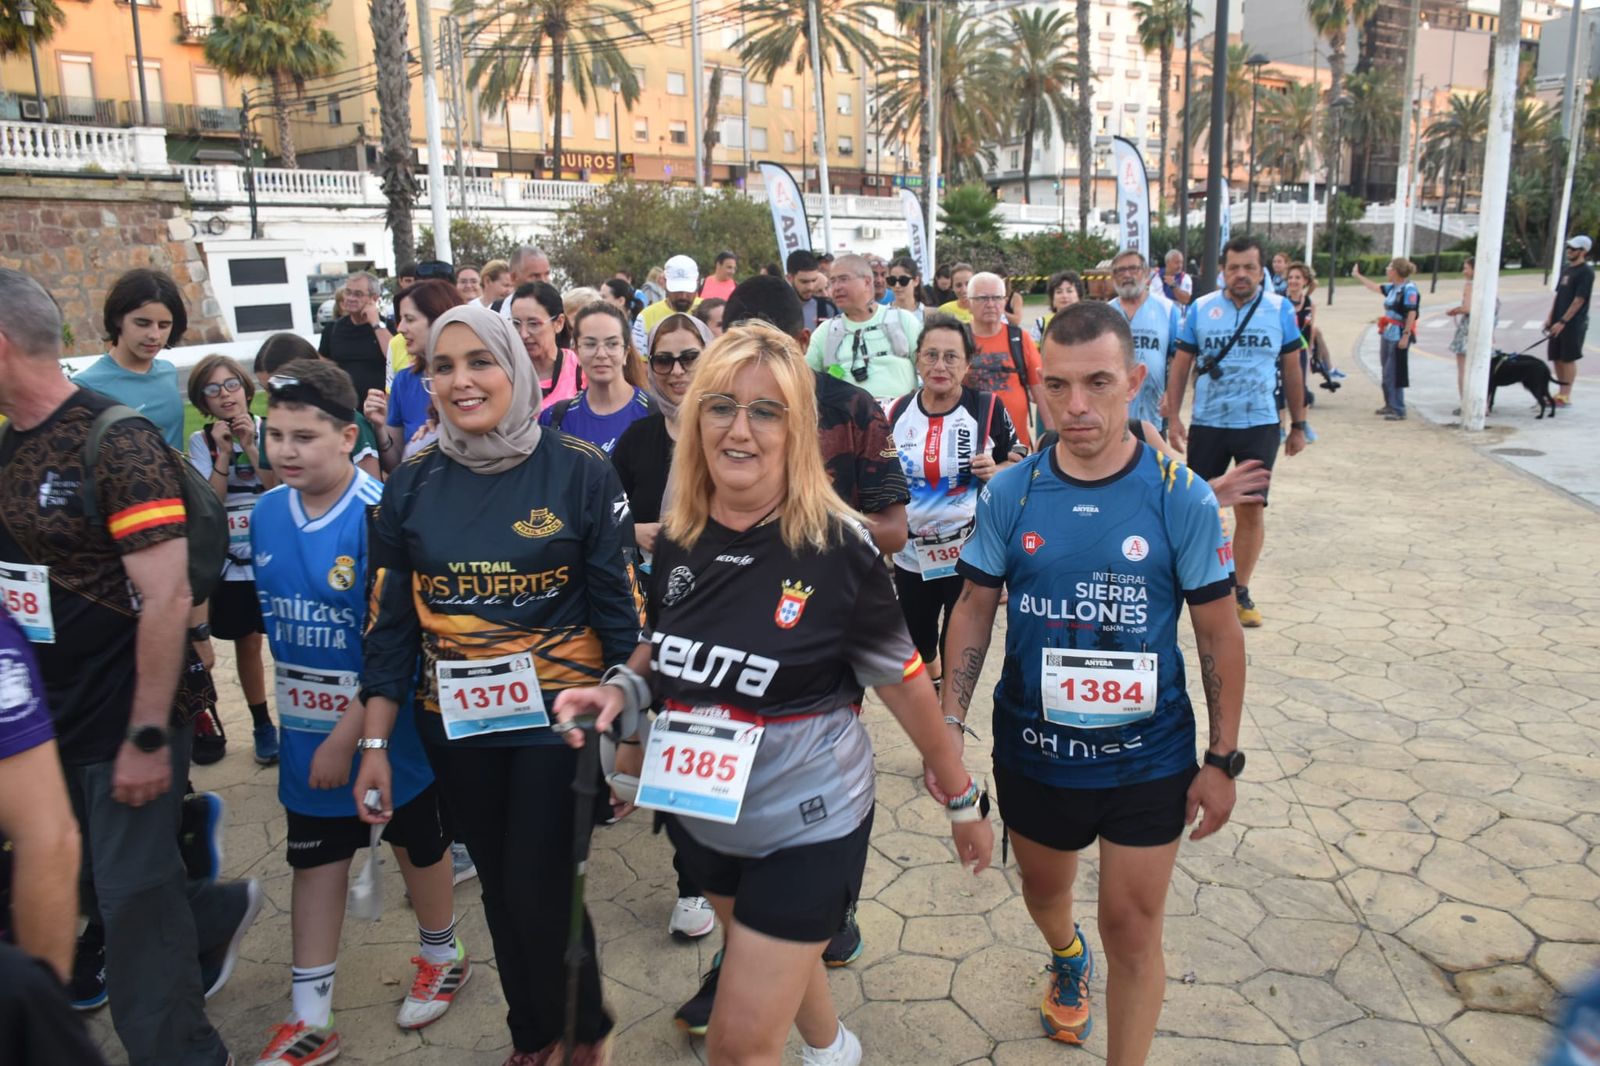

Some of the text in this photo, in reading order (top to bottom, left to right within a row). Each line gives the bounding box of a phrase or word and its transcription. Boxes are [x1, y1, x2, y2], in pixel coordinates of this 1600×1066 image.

[1133, 335, 1160, 351] ERA
[926, 546, 960, 562] 138
[448, 562, 517, 574] VI TRAIL
[1092, 571, 1147, 586] INTEGRAL
[420, 565, 570, 597] OS FUERTES
[1075, 582, 1148, 602] SIERRA
[1019, 593, 1148, 625] BULLONES
[288, 687, 349, 712] 1382
[453, 681, 529, 710] 1370
[1060, 678, 1144, 704] 1384
[661, 745, 739, 782] 1385
